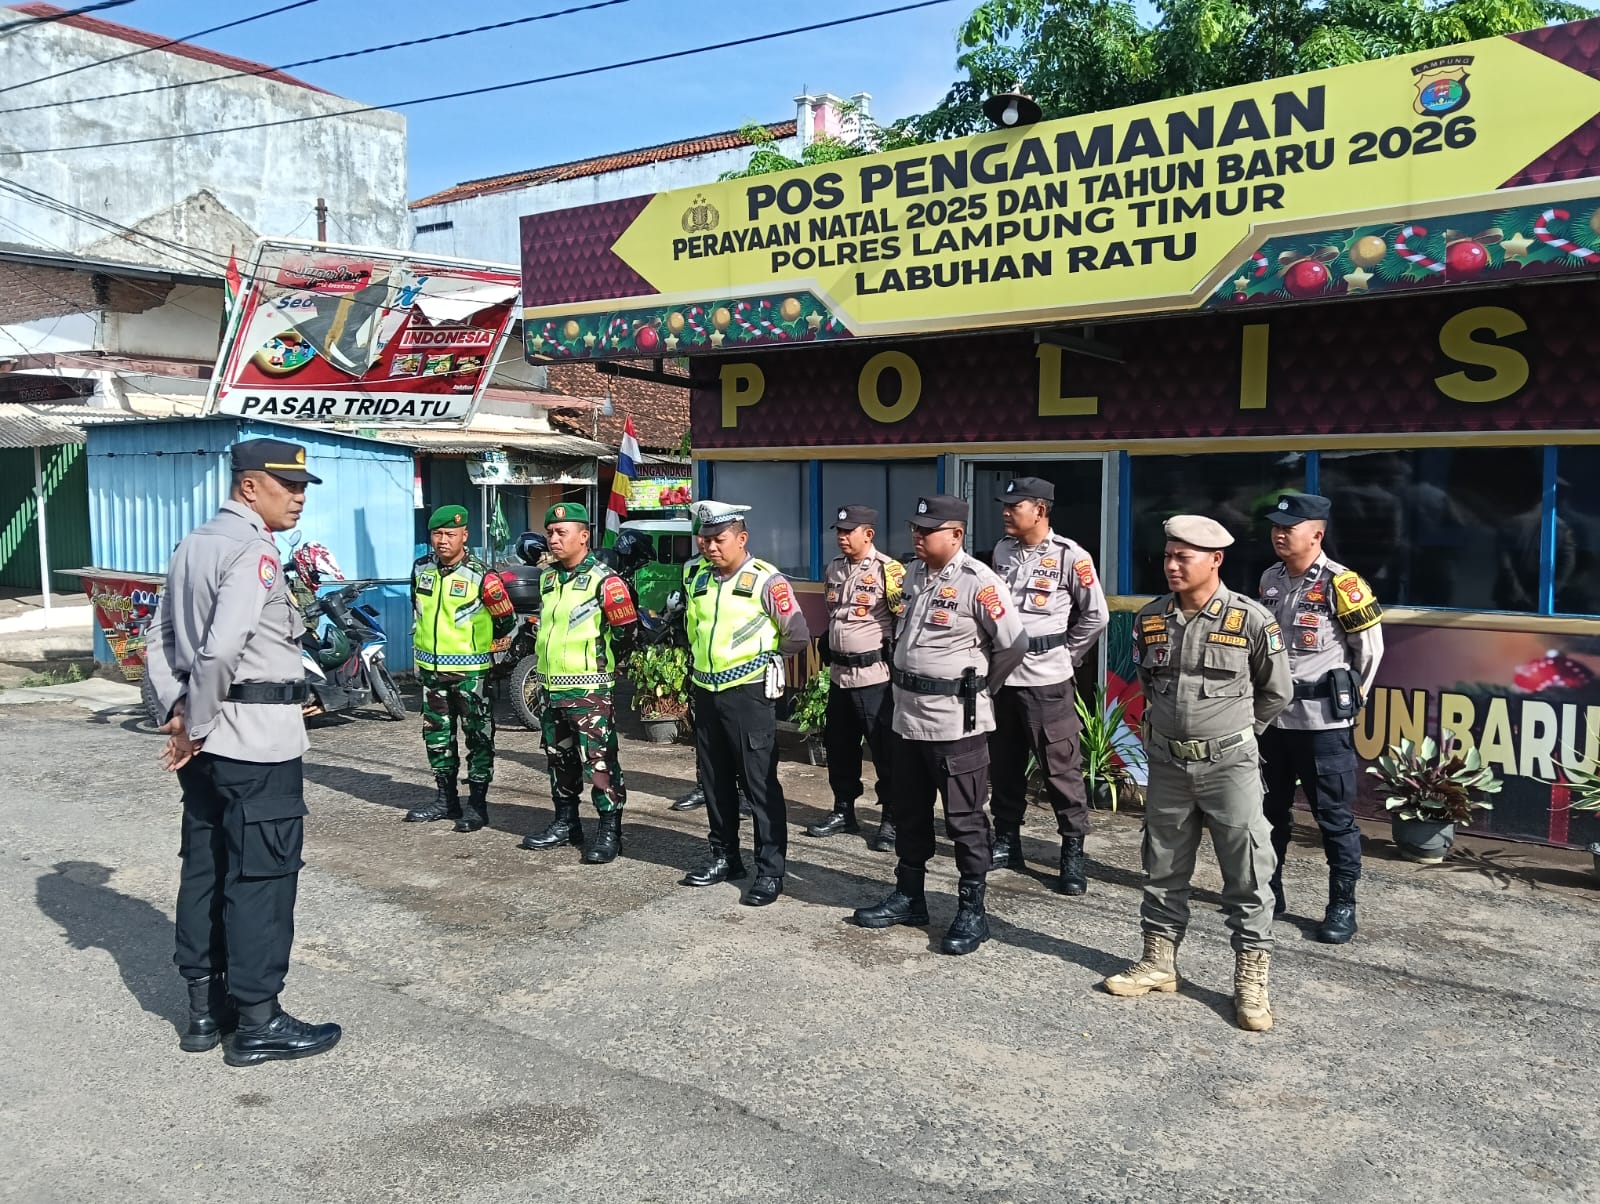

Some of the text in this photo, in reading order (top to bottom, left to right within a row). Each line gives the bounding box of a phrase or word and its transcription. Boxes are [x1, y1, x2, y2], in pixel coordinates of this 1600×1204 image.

[1415, 58, 1470, 73] LAMPUNG
[747, 86, 1325, 221] POS PENGAMANAN
[673, 116, 1476, 260] PERAYAAN NATAL 2025 DAN TAHUN BARU 2026
[772, 183, 1284, 273] POLRES LAMPUNG TIMUR
[855, 232, 1196, 295] LABUHAN RATU
[403, 331, 490, 345] INDONESIA
[722, 307, 1529, 426] POLIS
[241, 397, 451, 416] PASAR TRIDATU
[855, 585, 876, 593] POLRI
[1033, 569, 1059, 579] POLRI
[931, 599, 958, 611] POLRI
[1439, 692, 1600, 785] BARU
